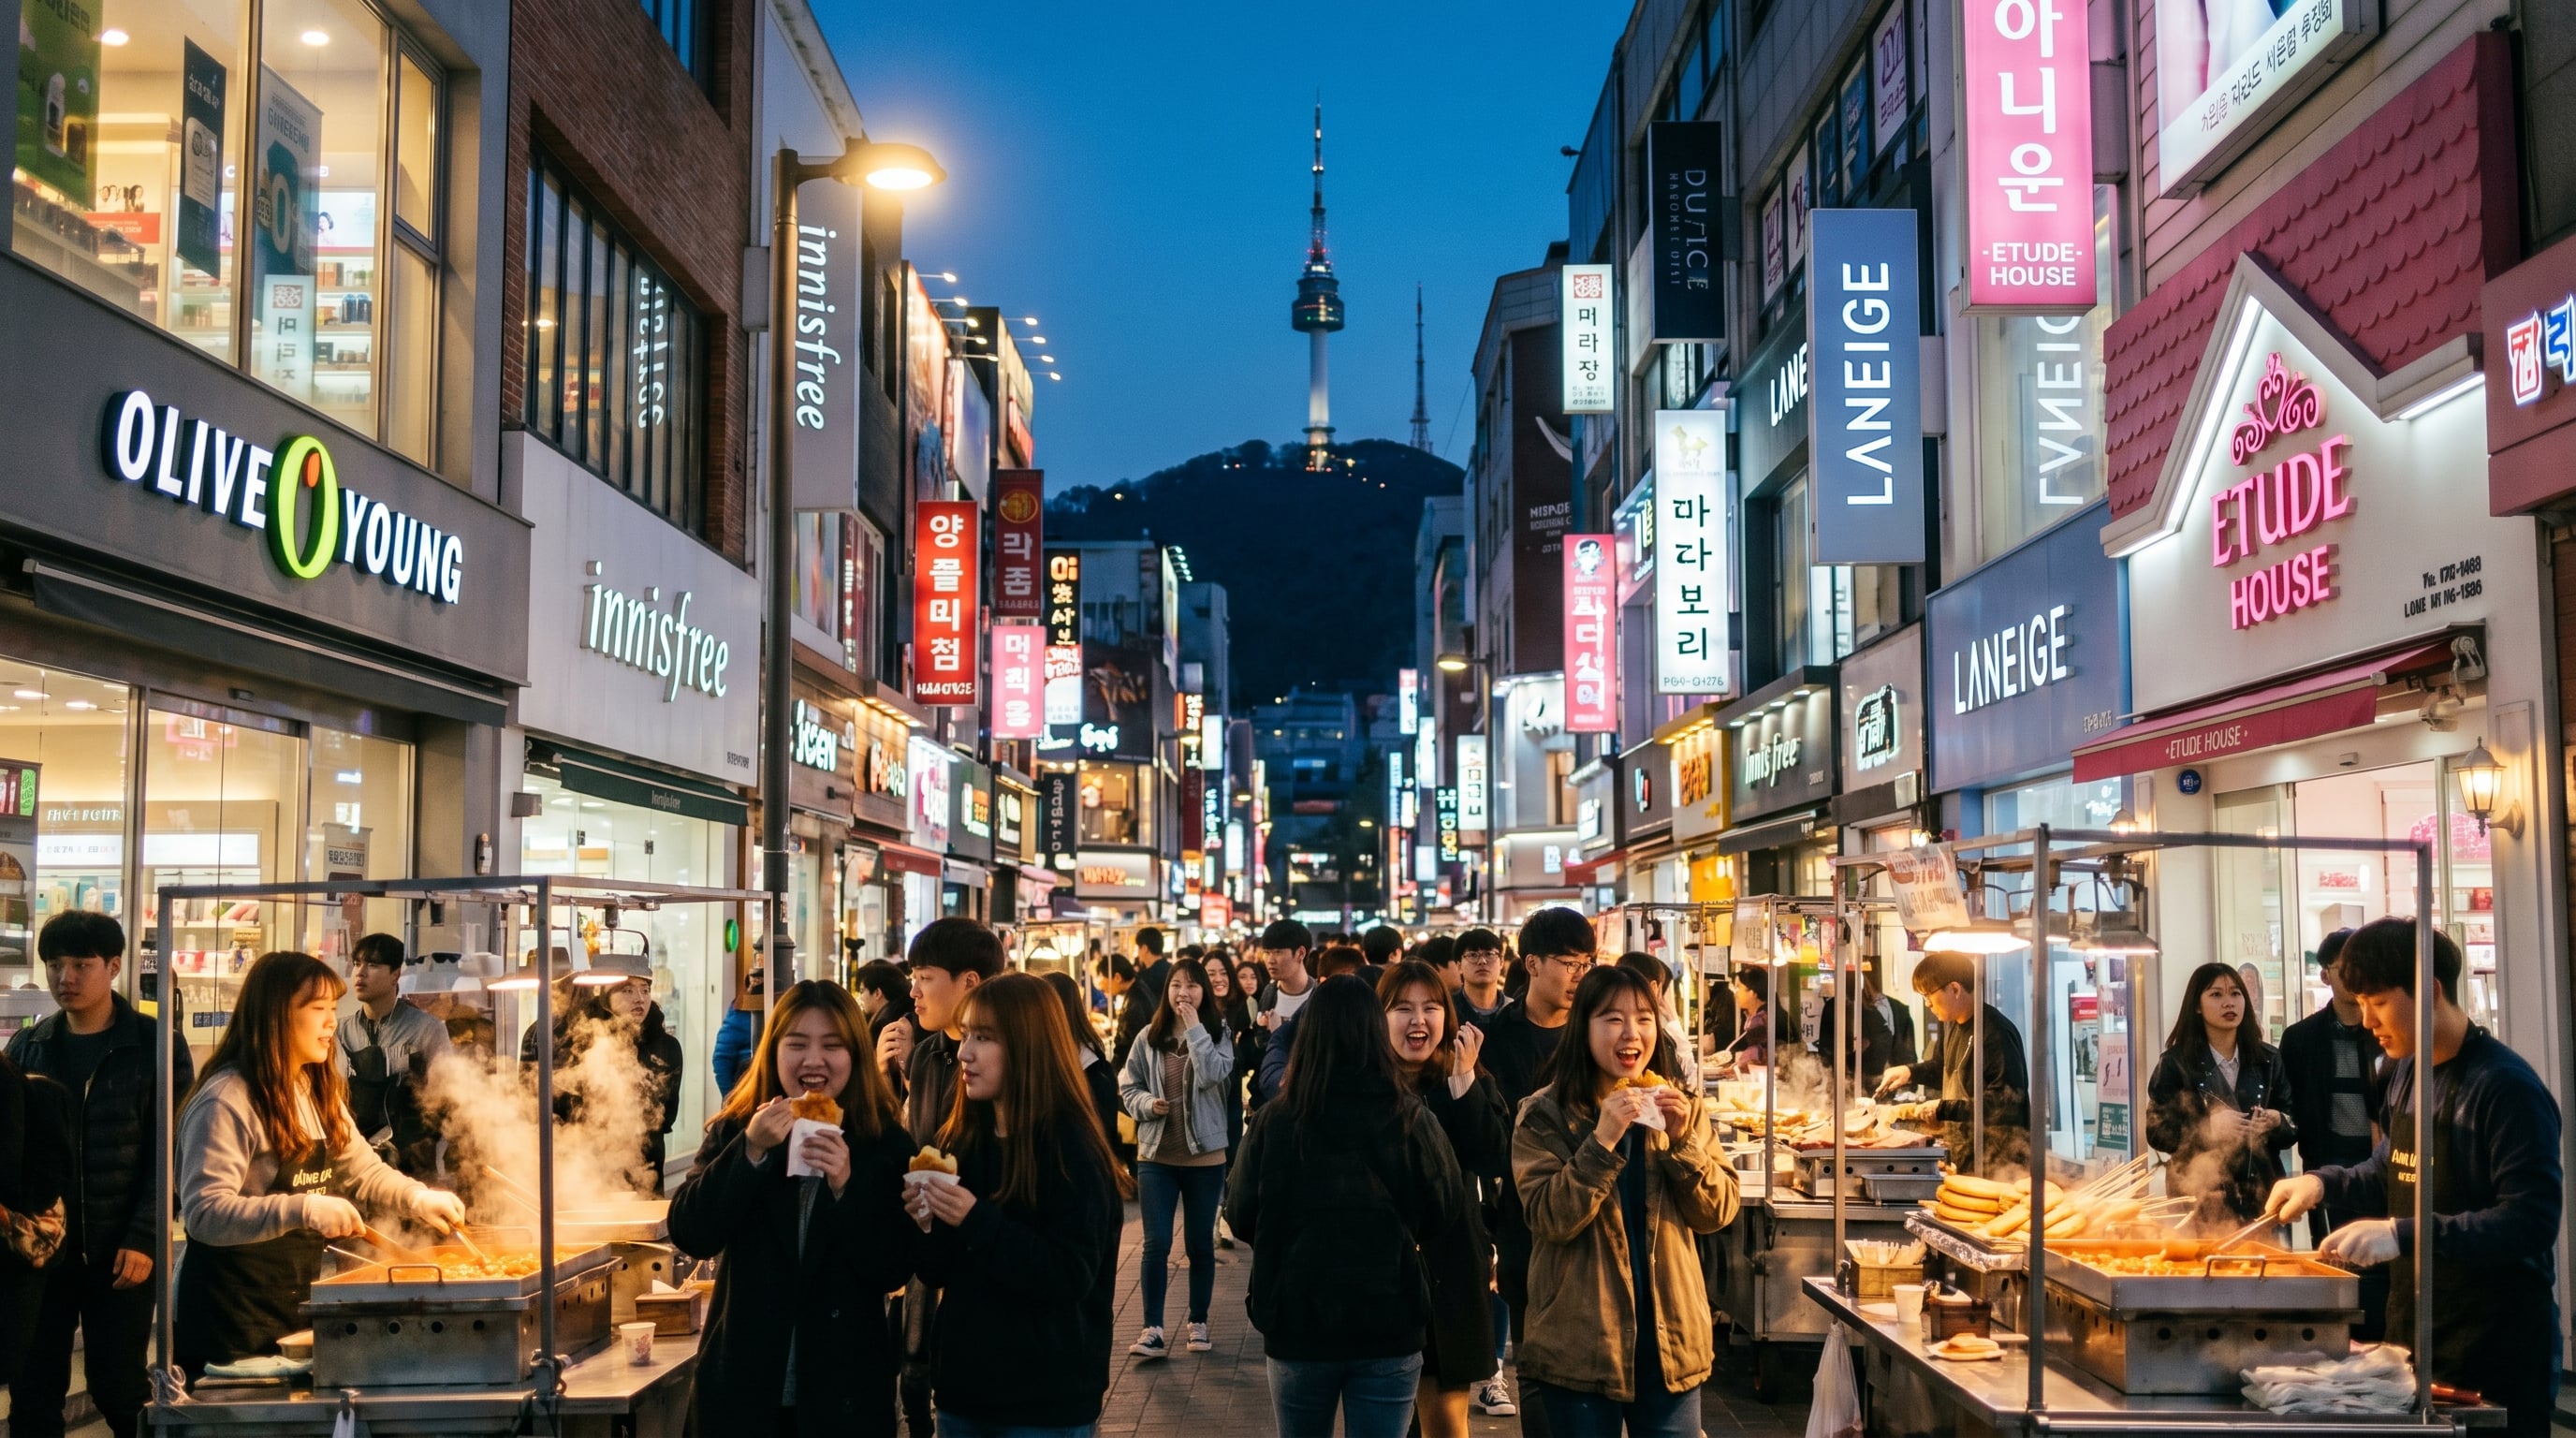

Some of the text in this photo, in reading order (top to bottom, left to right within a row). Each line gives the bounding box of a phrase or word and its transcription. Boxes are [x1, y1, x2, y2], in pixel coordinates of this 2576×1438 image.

[795, 224, 842, 431] innisfree
[1990, 266, 2077, 286] HOUSE
[1841, 261, 1895, 506] LANEIGE
[110, 389, 272, 530] OLIVE
[343, 487, 463, 605] YOUNG
[2211, 433, 2355, 567] ETUDE
[585, 560, 729, 703] innisfree
[2231, 544, 2336, 630] HOUSE
[1954, 604, 2069, 715] LANEIGE
[2170, 725, 2241, 759] ETUDE HOUSE
